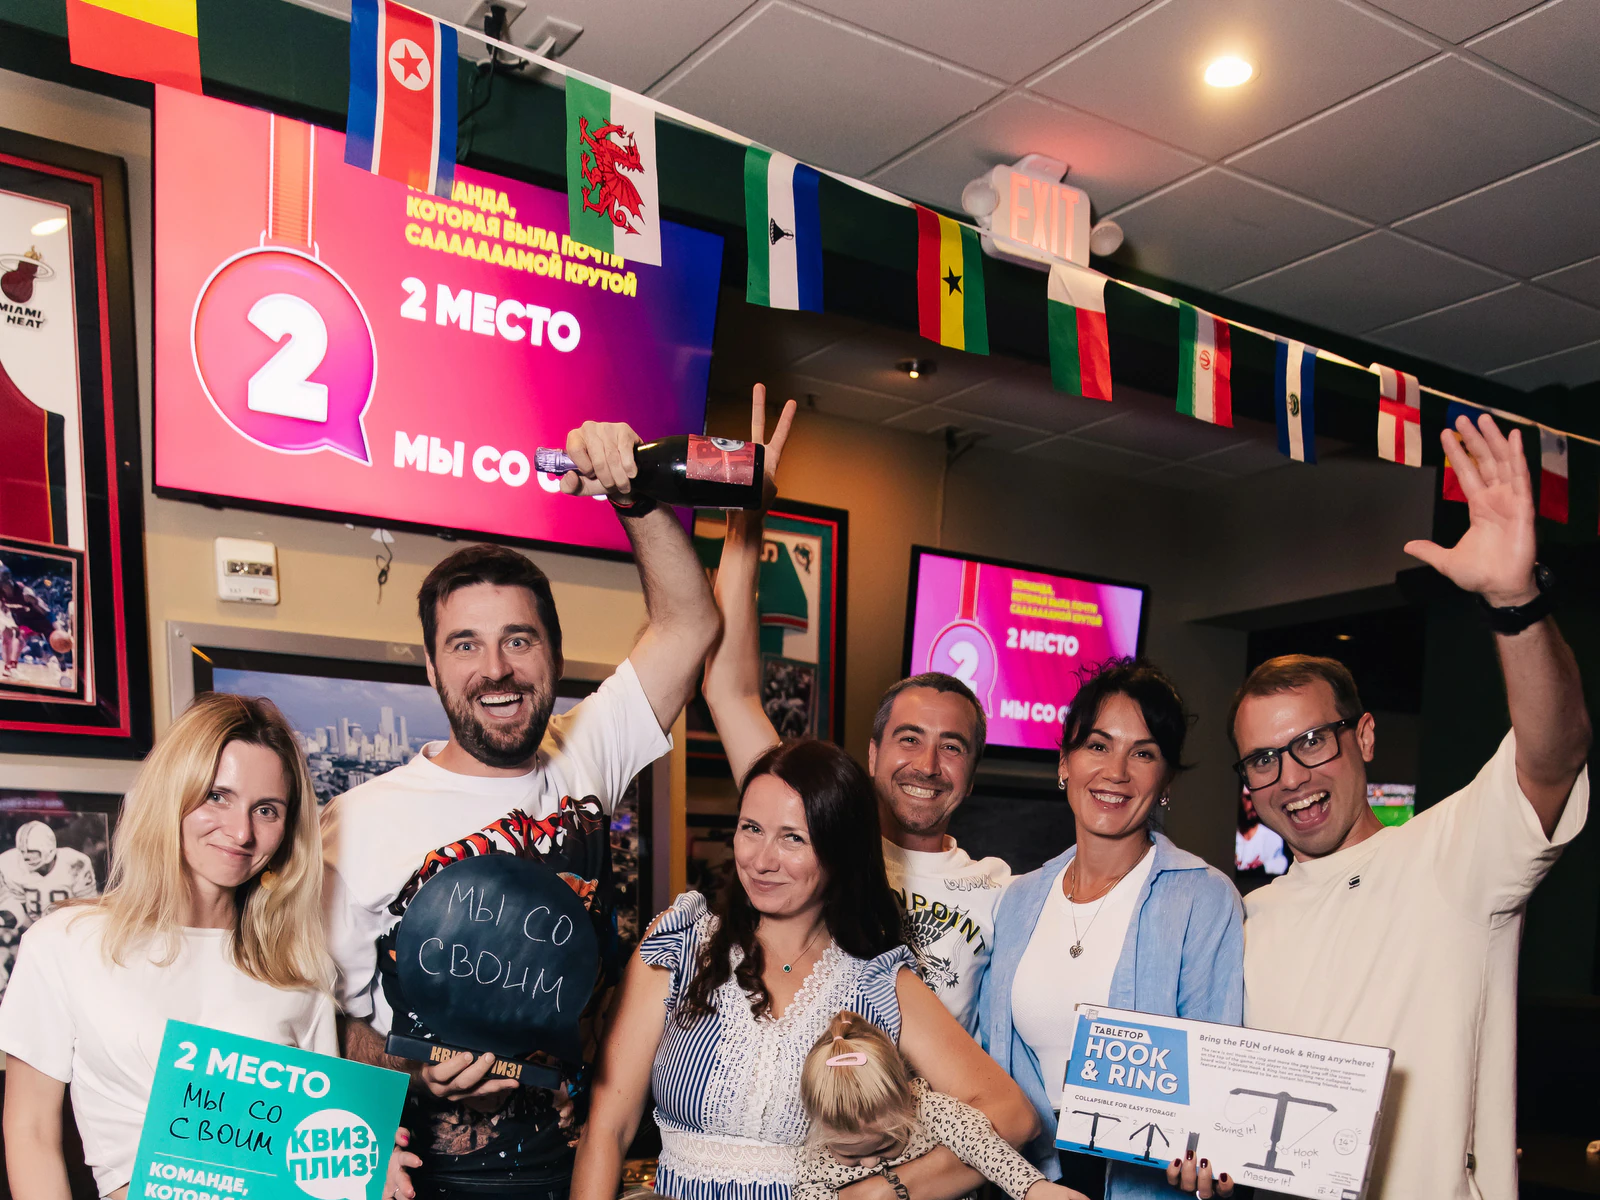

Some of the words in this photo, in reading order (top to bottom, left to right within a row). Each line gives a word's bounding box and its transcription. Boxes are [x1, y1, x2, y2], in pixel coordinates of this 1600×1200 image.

[406, 194, 501, 239] КОТОРАЯ
[502, 219, 560, 254] БЫЛА
[1009, 171, 1079, 262] EXIT
[564, 260, 638, 298] КРУТОЙ
[0, 302, 41, 318] MIAMI
[6, 315, 44, 329] HEAT
[400, 276, 427, 322] 2
[435, 283, 582, 353] МЕСТО
[246, 292, 329, 423] 2
[393, 430, 465, 478] МЫ
[471, 444, 531, 487] СО
[1006, 627, 1019, 649] 2
[1020, 629, 1079, 657] МЕСТО
[948, 641, 979, 693] 2
[1000, 699, 1030, 721] МЫ
[1031, 702, 1056, 723] СО
[448, 881, 505, 926] МЫ
[523, 905, 573, 946] СО
[891, 887, 986, 956] NPOINT
[418, 937, 564, 1012] СВОИМ
[1094, 1025, 1144, 1040] TABLETOP
[1084, 1037, 1171, 1070] HOOK
[1199, 1034, 1221, 1045] Bring
[1223, 1038, 1237, 1047] the
[1240, 1039, 1261, 1050] FUN
[1262, 1043, 1272, 1051] of
[1273, 1045, 1295, 1056] Hook
[1306, 1051, 1326, 1062] Ring
[1328, 1055, 1375, 1068] Anywhere!
[173, 1041, 198, 1071] 2
[205, 1047, 331, 1099] МЕСТО
[1080, 1059, 1100, 1082] &
[1108, 1063, 1179, 1095] RING
[183, 1082, 225, 1112] МЫ
[248, 1100, 283, 1124] СО
[1074, 1094, 1114, 1107] COLLAPSIBLE
[1114, 1101, 1128, 1109] FOR
[1128, 1104, 1144, 1112] EASY
[1144, 1106, 1177, 1118] STORAGE!
[169, 1117, 274, 1156] СВОИМ
[290, 1125, 378, 1154] КВИЗ,
[1213, 1122, 1244, 1138] Swing
[1245, 1124, 1257, 1135] It!
[289, 1151, 378, 1182] ПЛИЗ!
[1293, 1148, 1319, 1157] Hook
[1301, 1159, 1311, 1169] It!
[148, 1161, 249, 1196] КОМАНДЕ,
[1243, 1170, 1279, 1184] Master
[1280, 1176, 1291, 1187] It!
